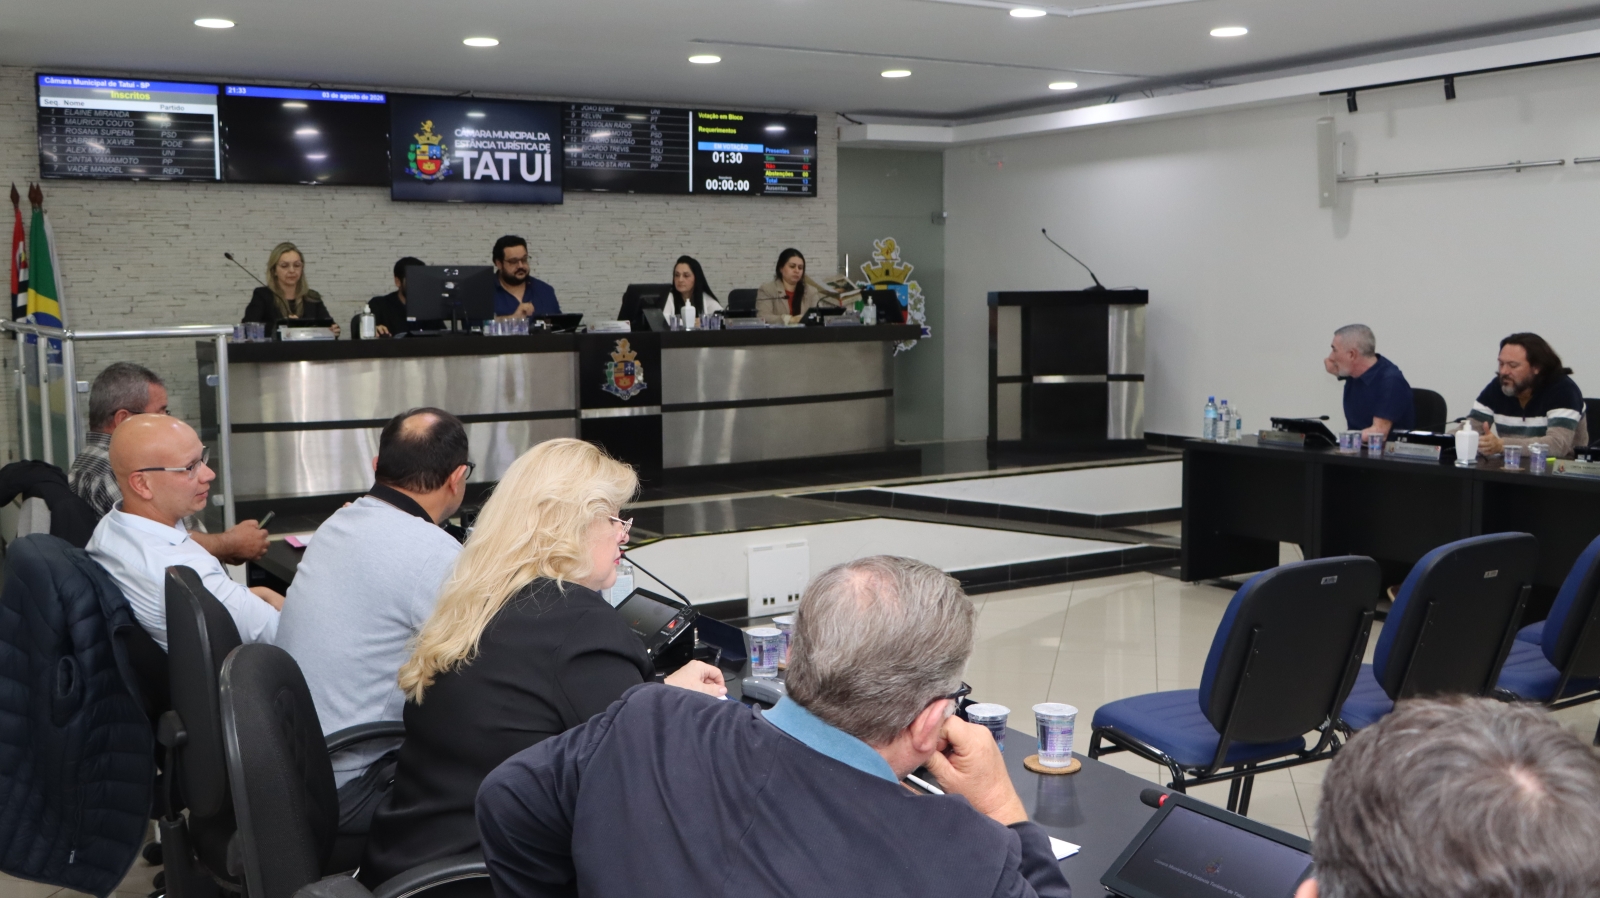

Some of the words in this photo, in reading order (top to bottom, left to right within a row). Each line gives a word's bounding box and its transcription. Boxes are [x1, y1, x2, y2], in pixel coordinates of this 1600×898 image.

[73, 78, 106, 87] Municipal
[111, 90, 150, 100] Inscritos
[454, 127, 492, 138] CÂMARA
[493, 130, 537, 140] MUNICIPAL
[538, 132, 550, 141] DA
[454, 139, 496, 149] ESTÂNCIA
[497, 140, 538, 151] TURÍSTICA
[539, 143, 551, 151] DE
[712, 151, 742, 164] 01:30
[706, 179, 750, 191] 00:00:00
